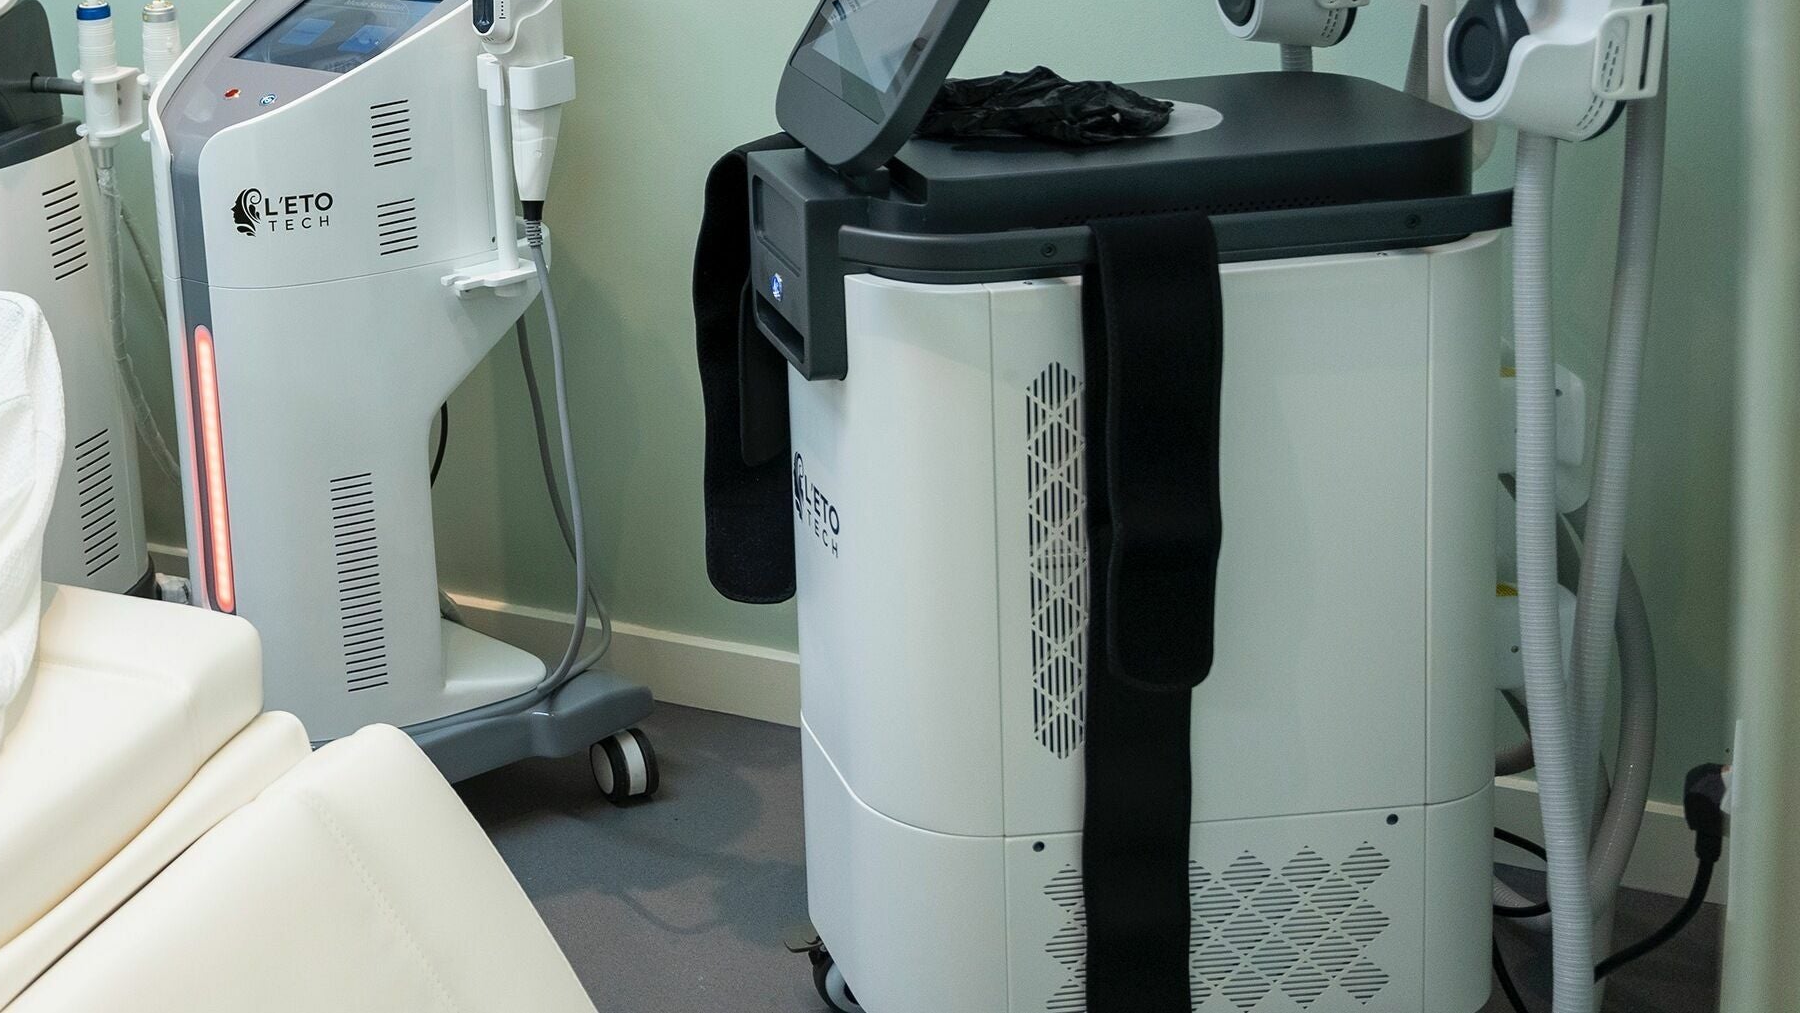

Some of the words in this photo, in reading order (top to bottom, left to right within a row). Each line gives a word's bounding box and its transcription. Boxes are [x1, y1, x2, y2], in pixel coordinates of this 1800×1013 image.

[265, 192, 333, 216] L'ETO
[268, 215, 329, 232] TECH
[804, 474, 840, 536] L'ETO
[807, 508, 839, 559] TECH
